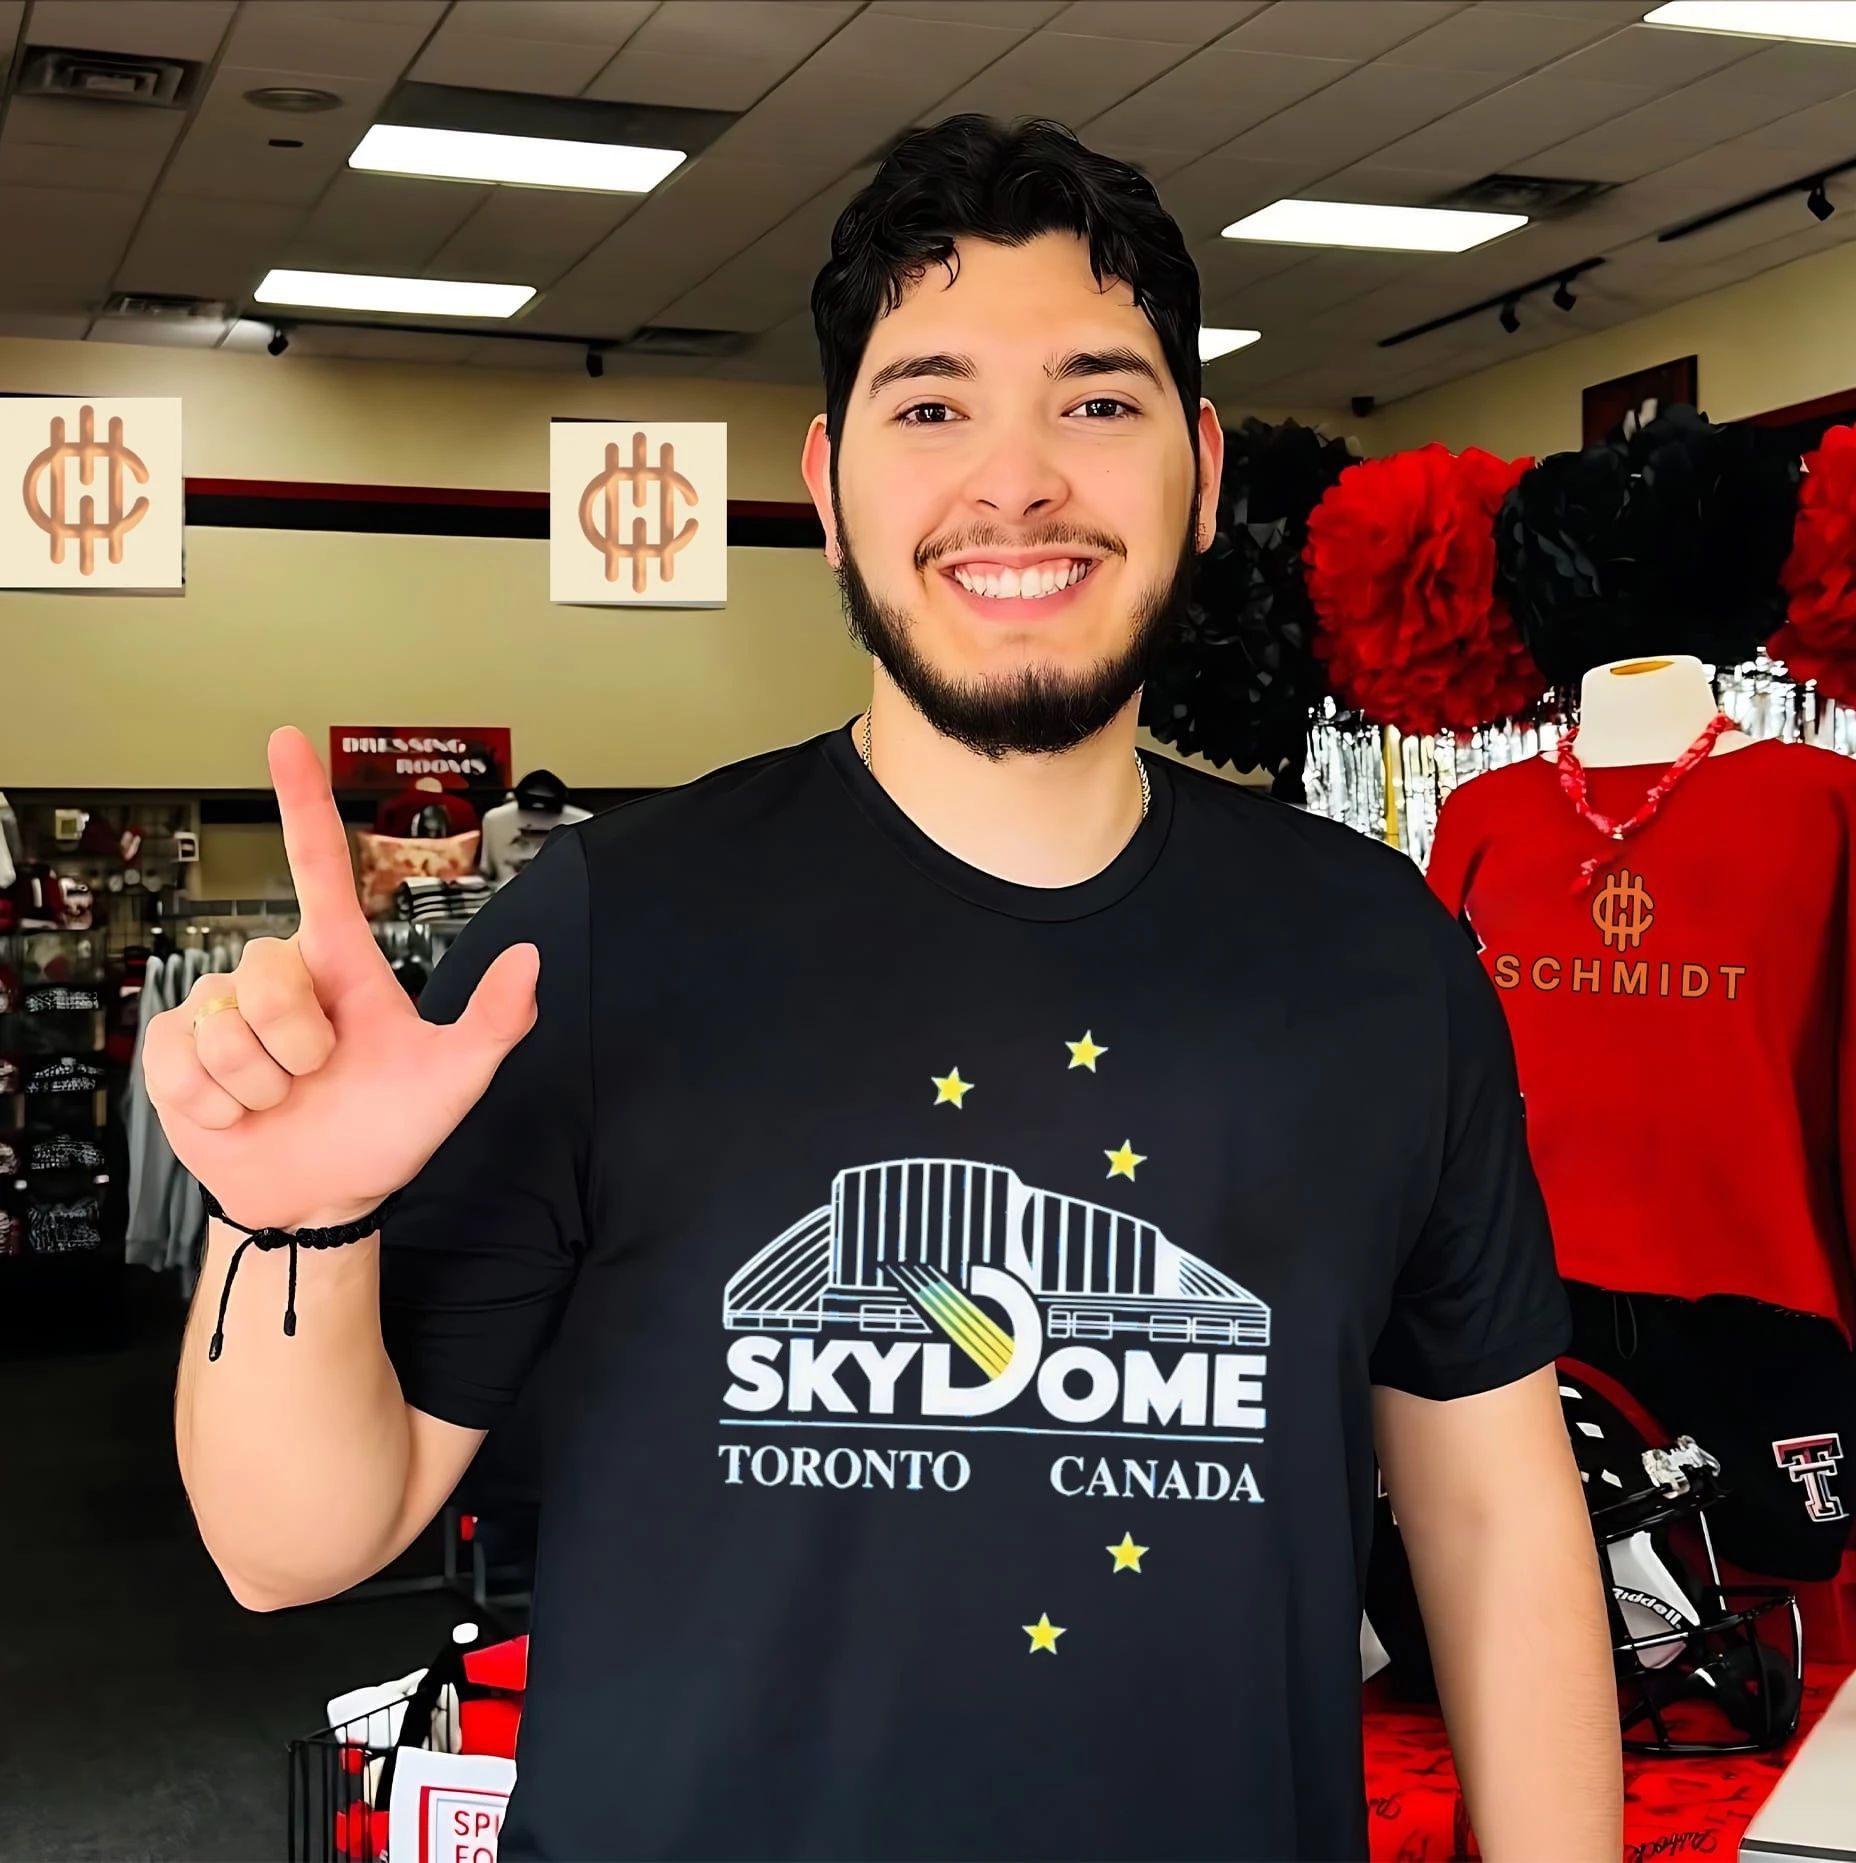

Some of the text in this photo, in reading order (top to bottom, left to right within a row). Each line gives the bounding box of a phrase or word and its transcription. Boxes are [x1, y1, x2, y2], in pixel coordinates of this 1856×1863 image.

[395, 758, 487, 775] ROOMS
[1494, 954, 1747, 1000] SCHMIDT
[718, 1444, 972, 1492] TORONTO
[1049, 1455, 1266, 1505] CANADA
